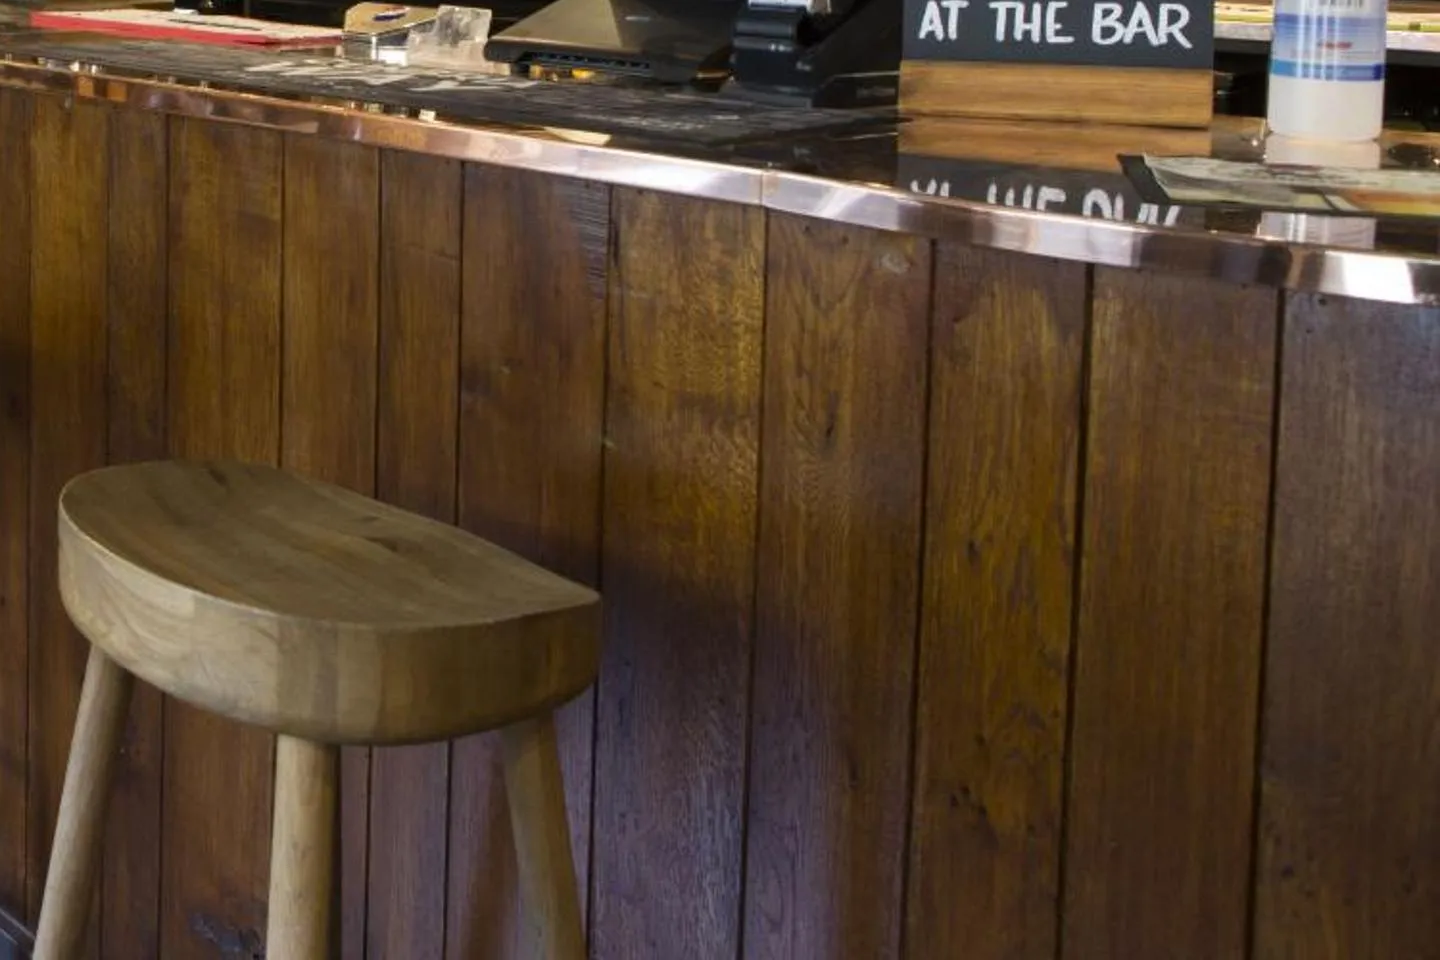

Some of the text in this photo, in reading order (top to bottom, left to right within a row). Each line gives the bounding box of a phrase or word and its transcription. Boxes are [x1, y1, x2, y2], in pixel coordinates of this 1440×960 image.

[919, 0, 1193, 49] AT THE BAR
